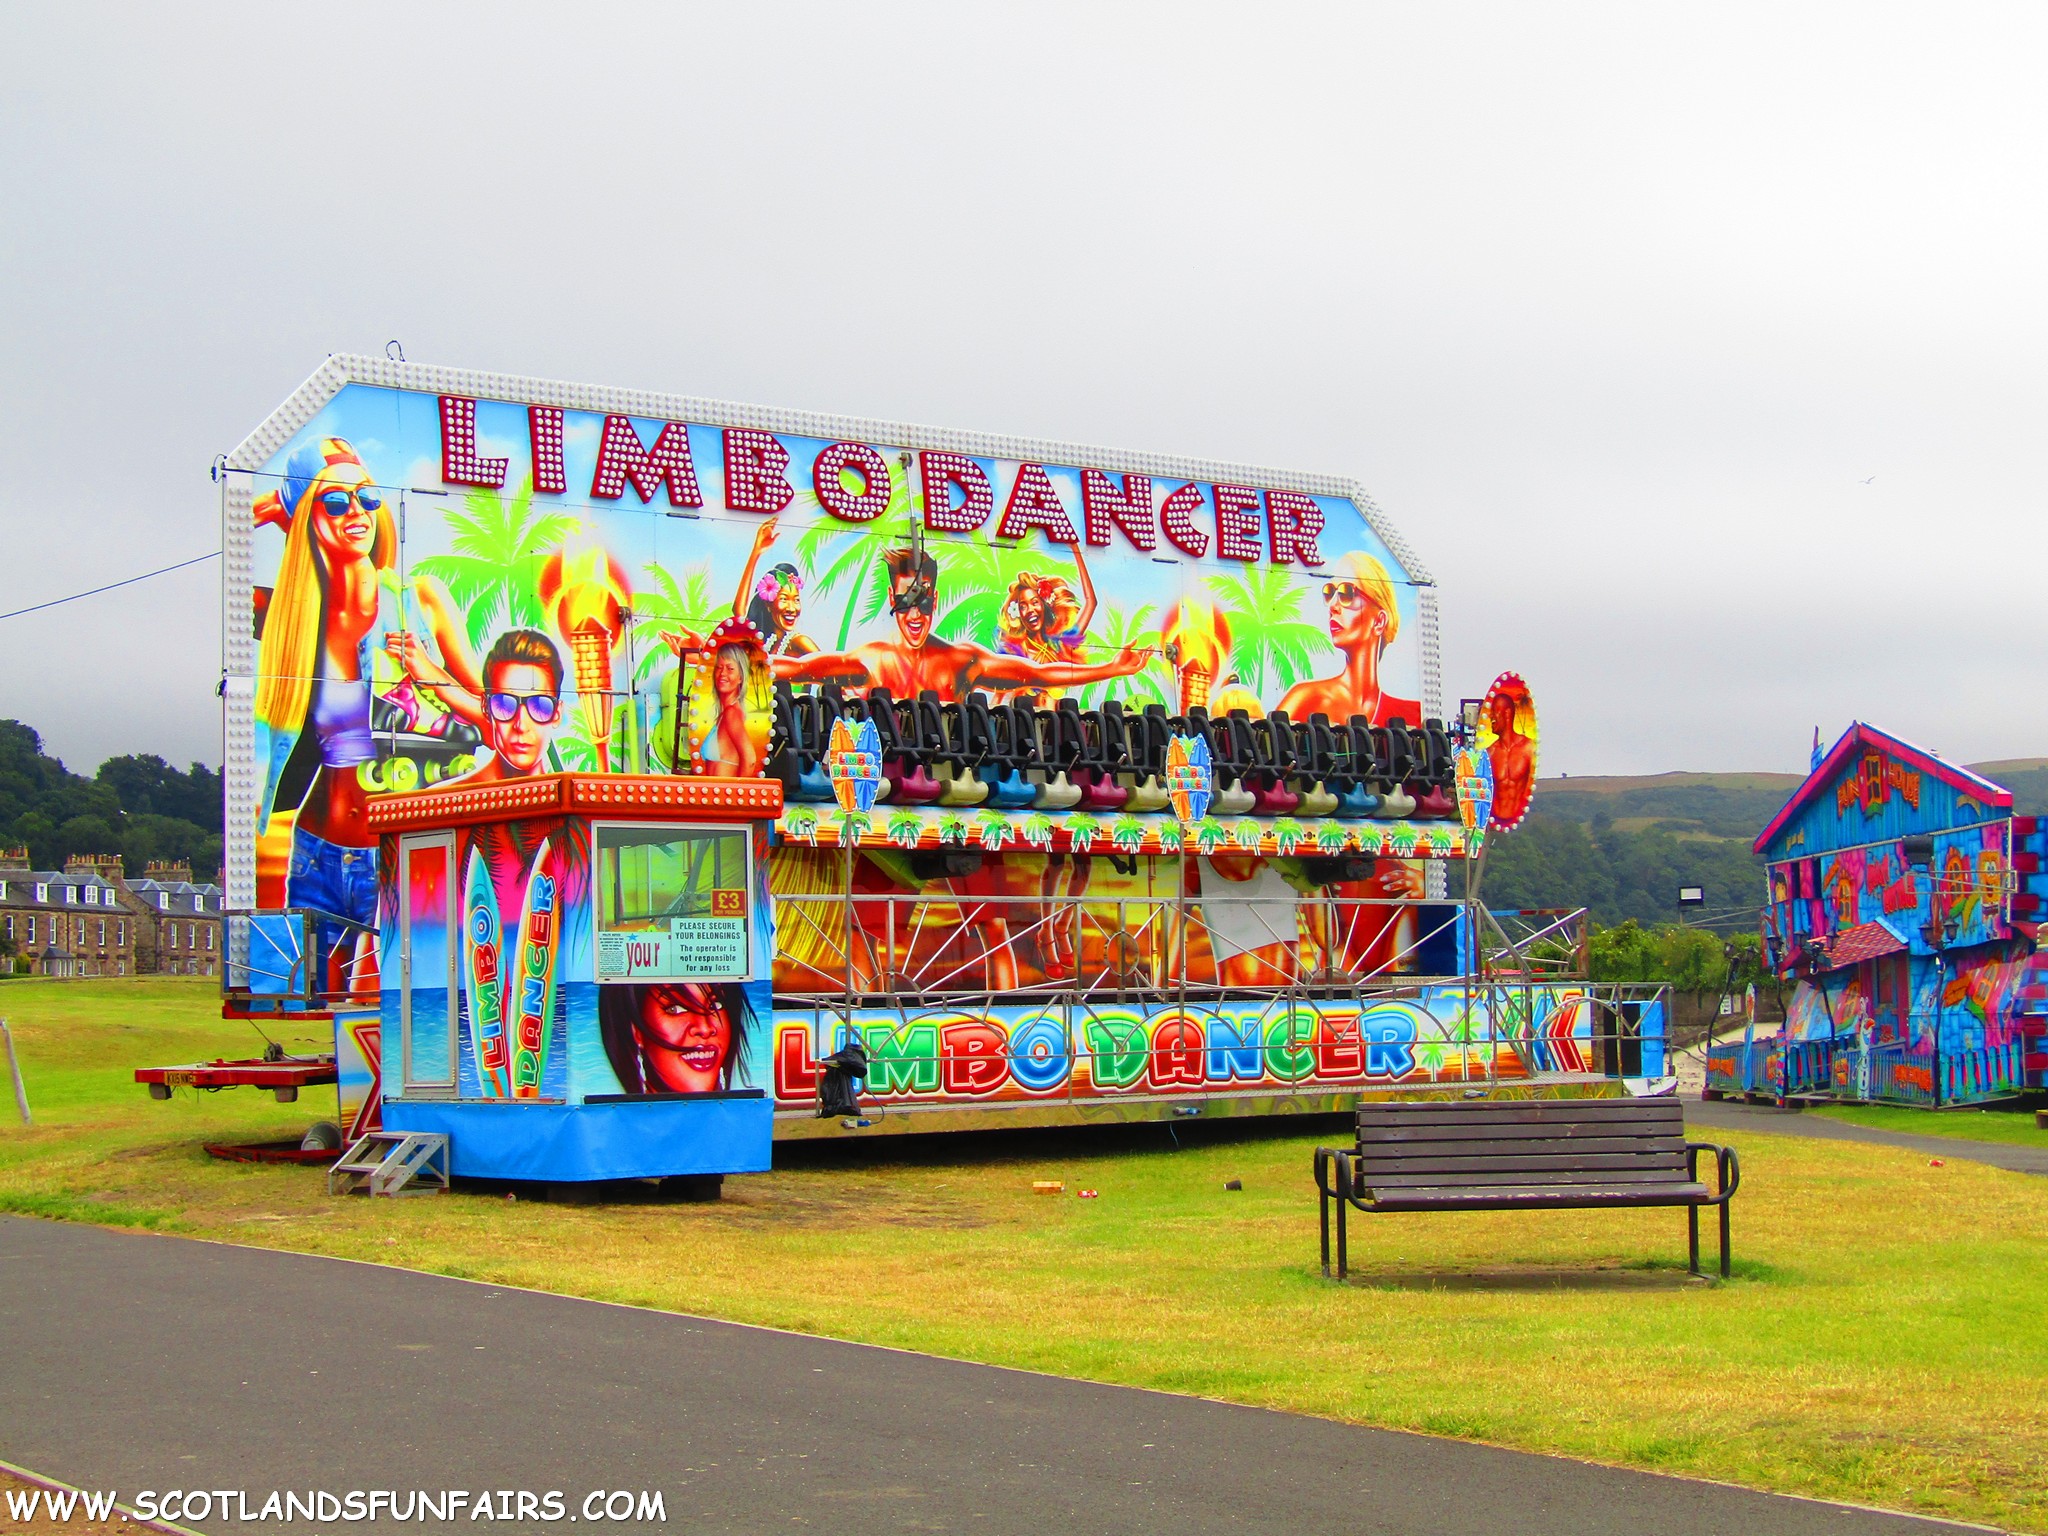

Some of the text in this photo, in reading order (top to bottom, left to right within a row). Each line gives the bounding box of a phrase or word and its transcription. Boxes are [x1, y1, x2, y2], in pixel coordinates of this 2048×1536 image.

[438, 395, 1325, 567] LIMBO DANCER
[838, 753, 875, 765] LIMBO
[832, 765, 879, 777] DANCER
[718, 892, 740, 909] £3
[680, 922, 706, 930] PLEASE
[680, 944, 693, 952] The
[696, 945, 727, 953] operator
[680, 954, 736, 962] not responsible
[686, 964, 697, 972] for
[700, 964, 712, 973] any
[513, 871, 556, 1088] DANCER
[468, 905, 506, 1071] LIMBO
[1087, 1011, 1417, 1087] DANCER
